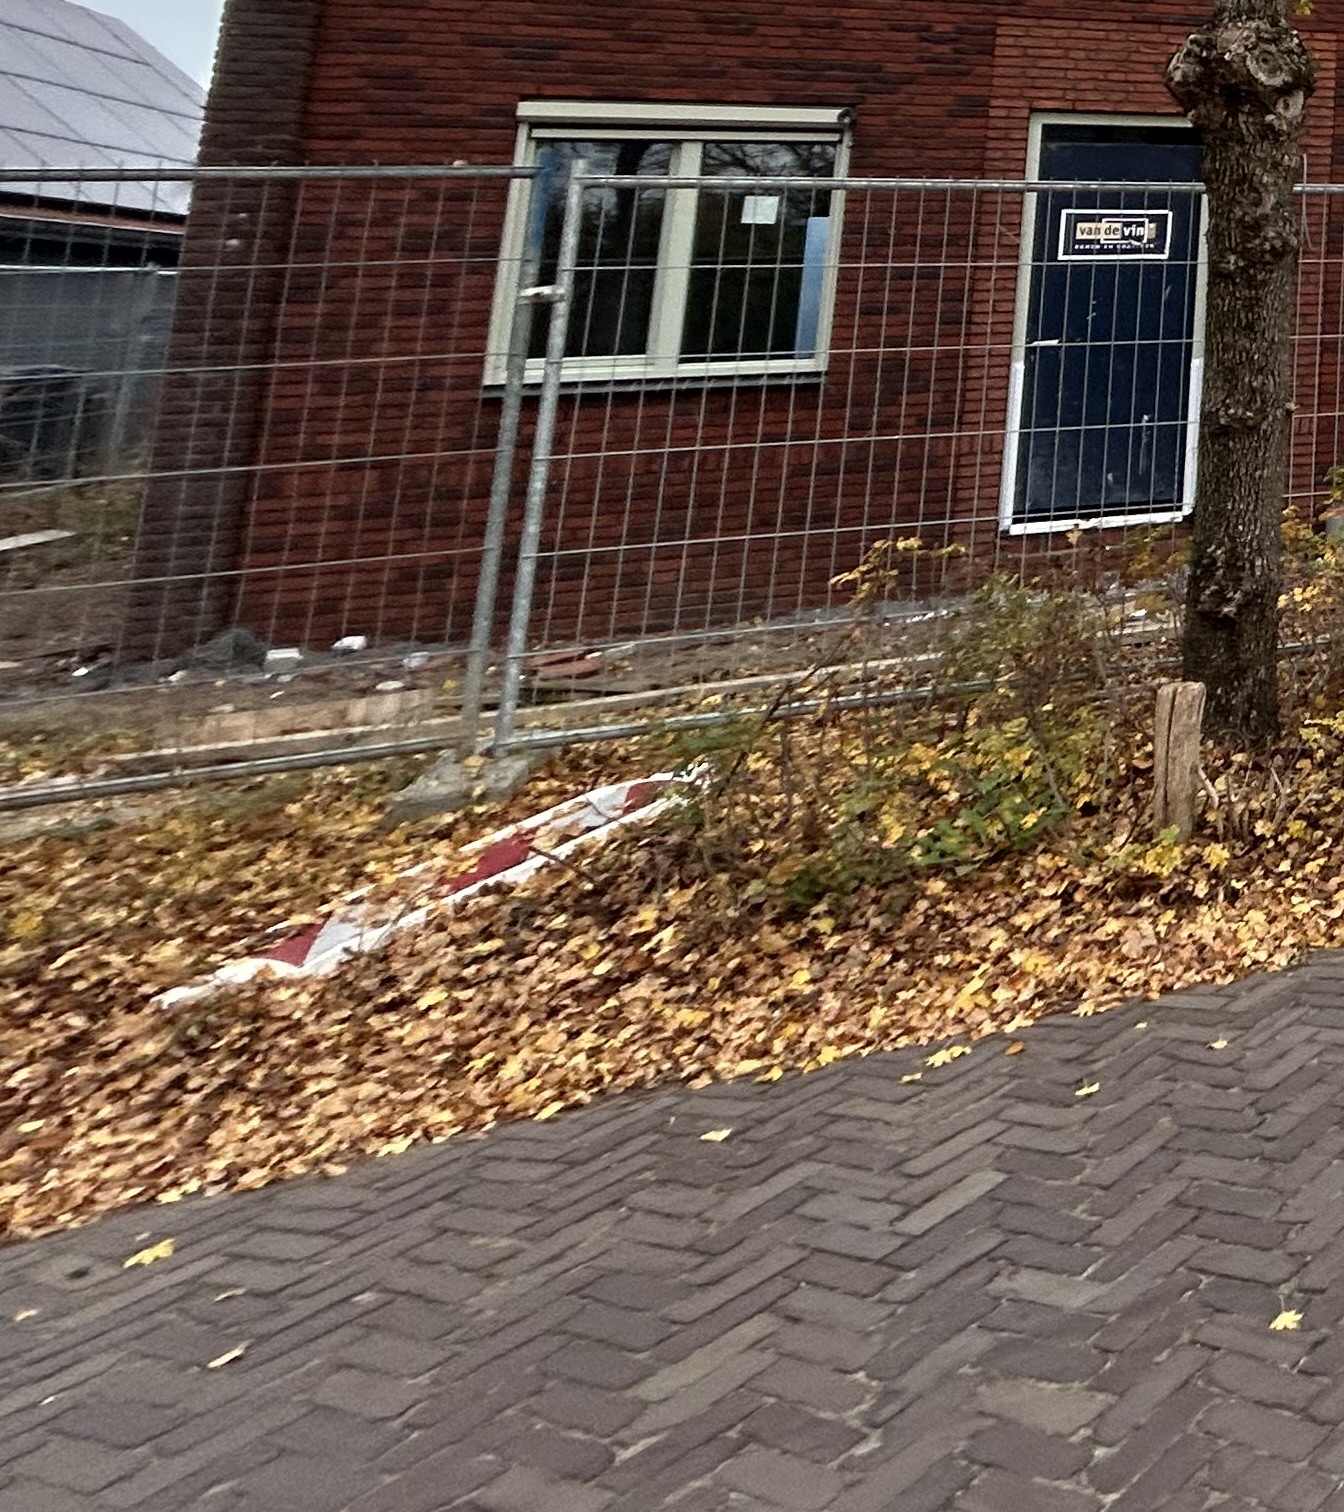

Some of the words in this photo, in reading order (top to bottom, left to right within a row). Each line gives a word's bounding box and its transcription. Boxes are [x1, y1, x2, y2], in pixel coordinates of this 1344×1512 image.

[1079, 226, 1101, 236] van
[1104, 225, 1120, 236] de
[1123, 224, 1144, 236] vin
